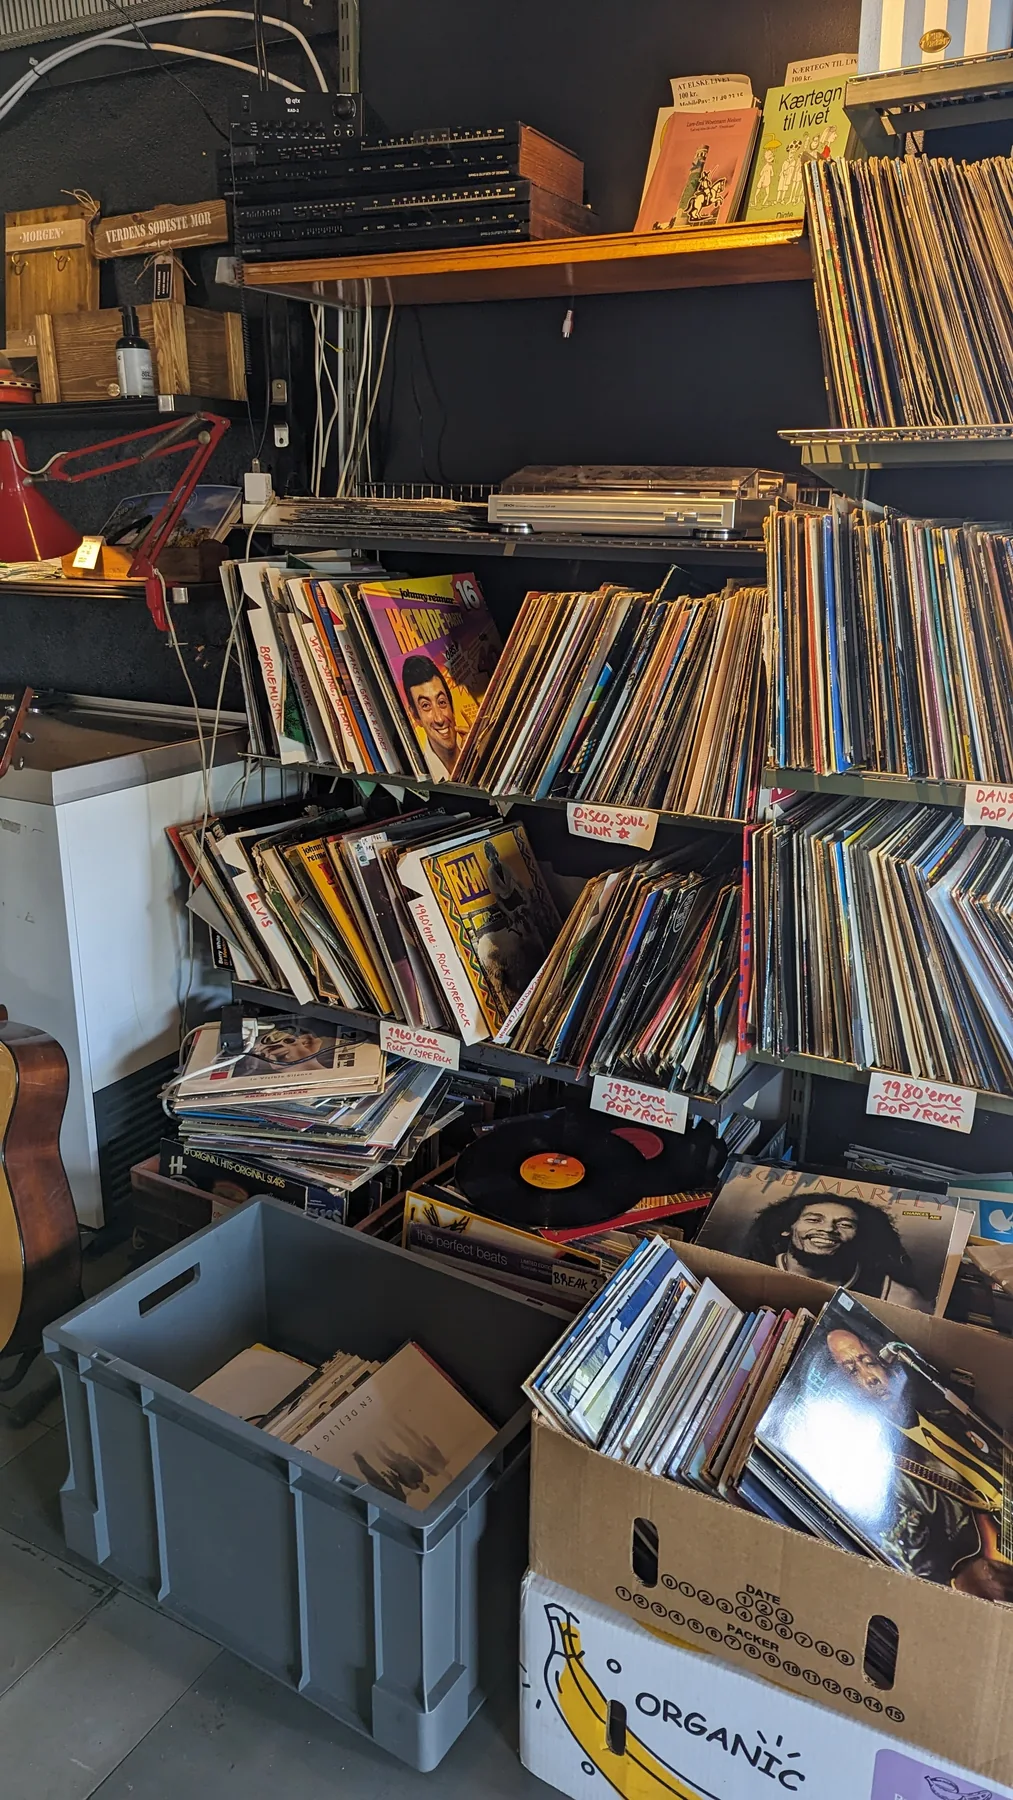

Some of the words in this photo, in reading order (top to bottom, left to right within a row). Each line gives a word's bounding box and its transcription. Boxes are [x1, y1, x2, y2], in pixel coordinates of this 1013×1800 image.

[832, 60, 846, 68] TIL
[846, 58, 858, 66] LIV
[678, 83, 687, 91] AT
[687, 78, 710, 88] ELSKE
[678, 92, 688, 100] 100
[778, 86, 843, 112] Kærtegn
[782, 110, 797, 132] til
[798, 107, 830, 129] livet
[105, 224, 146, 244] VERDENS
[190, 211, 212, 226] MOR
[456, 580, 480, 610] 16
[260, 645, 283, 720] BØRNEMUSIK
[976, 789, 1013, 804] DANS
[574, 820, 612, 838] FUNK
[616, 812, 650, 831] SOUL,
[246, 892, 274, 928] ELVIS
[388, 1026, 439, 1046] 1960'erne
[606, 1082, 666, 1107] 1970'erne
[882, 1080, 962, 1107] 1980'erne
[190, 1150, 220, 1167] ORIGINAL
[266, 1174, 286, 1190] STARS
[739, 1166, 796, 1188] BOB
[812, 1178, 953, 1212] MARLEY
[416, 1228, 434, 1244] the
[436, 1236, 474, 1256] perfect
[476, 1248, 508, 1266] beats
[553, 1272, 588, 1291] BREAK
[360, 1395, 373, 1409] EN
[322, 1409, 358, 1443] DEJLIG
[745, 1584, 781, 1606] DATE
[727, 1623, 780, 1653] PACKER
[635, 1692, 806, 1792] ORGANIC
